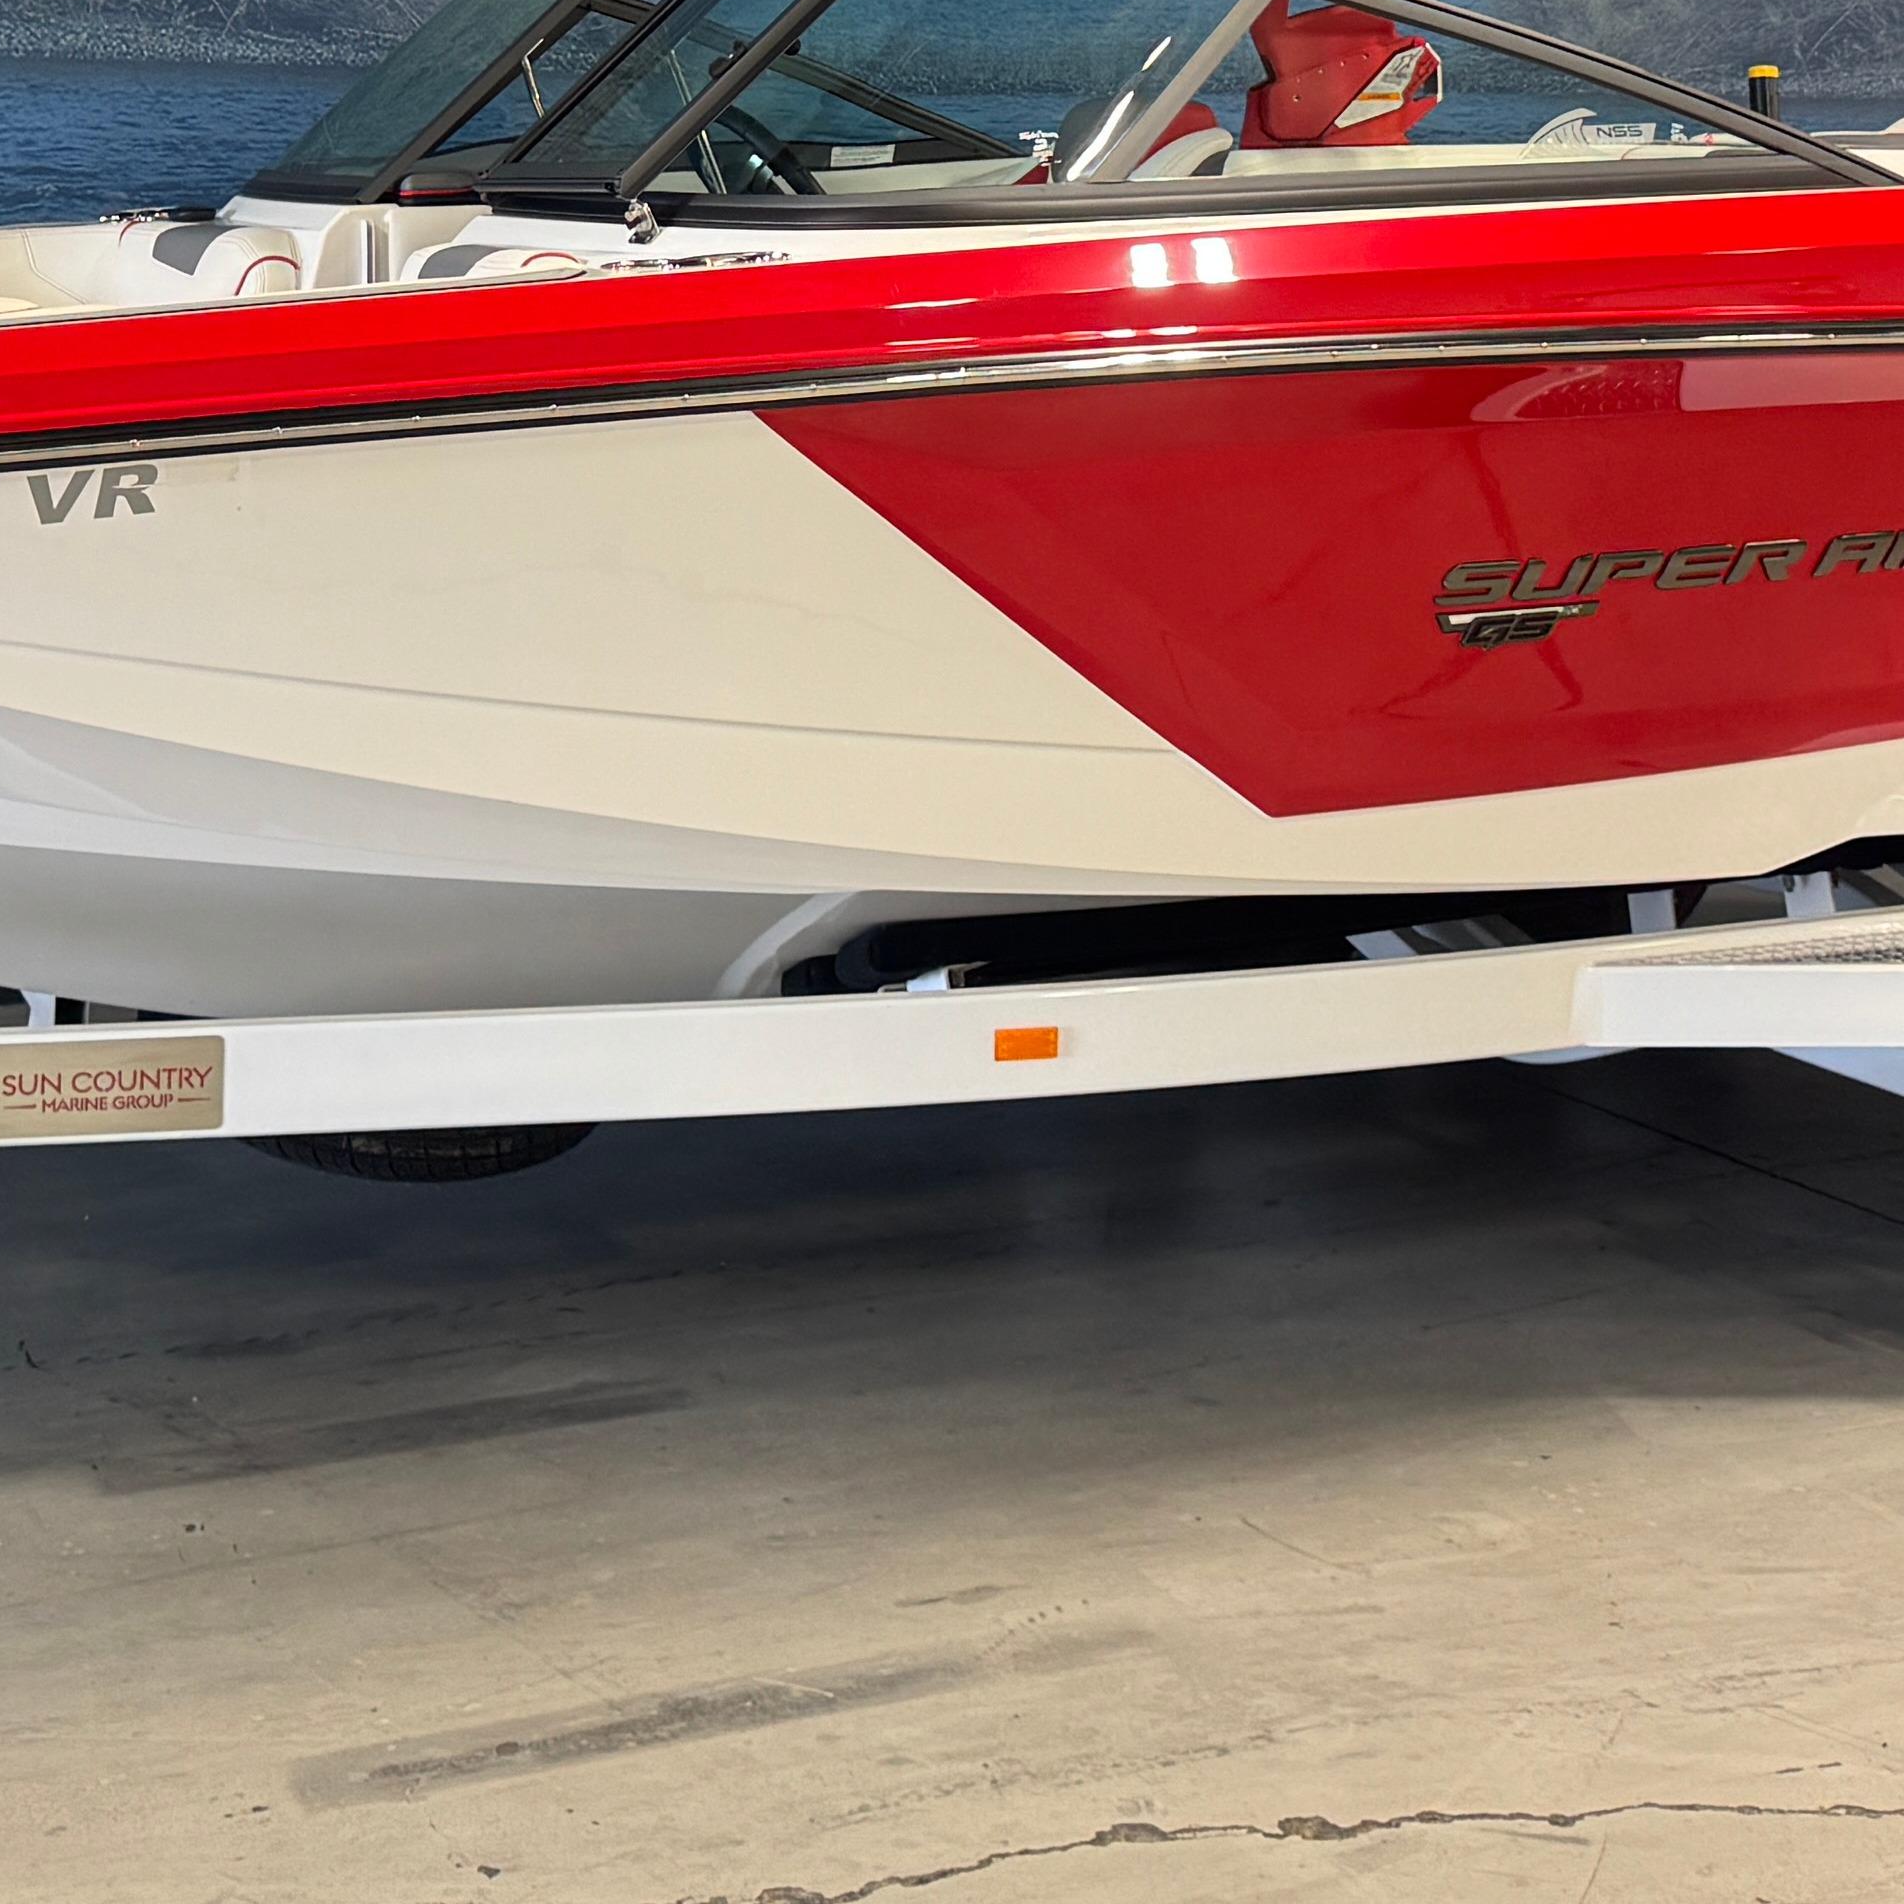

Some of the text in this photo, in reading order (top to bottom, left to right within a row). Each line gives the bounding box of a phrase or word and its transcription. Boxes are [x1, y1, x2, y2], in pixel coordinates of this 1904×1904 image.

[1596, 125, 1643, 138] NSS
[26, 463, 158, 525] VR
[1434, 539, 1807, 607] SUPER
[2, 1066, 213, 1096] SUN COUNTRY
[41, 1093, 173, 1113] MARINE GROUP
